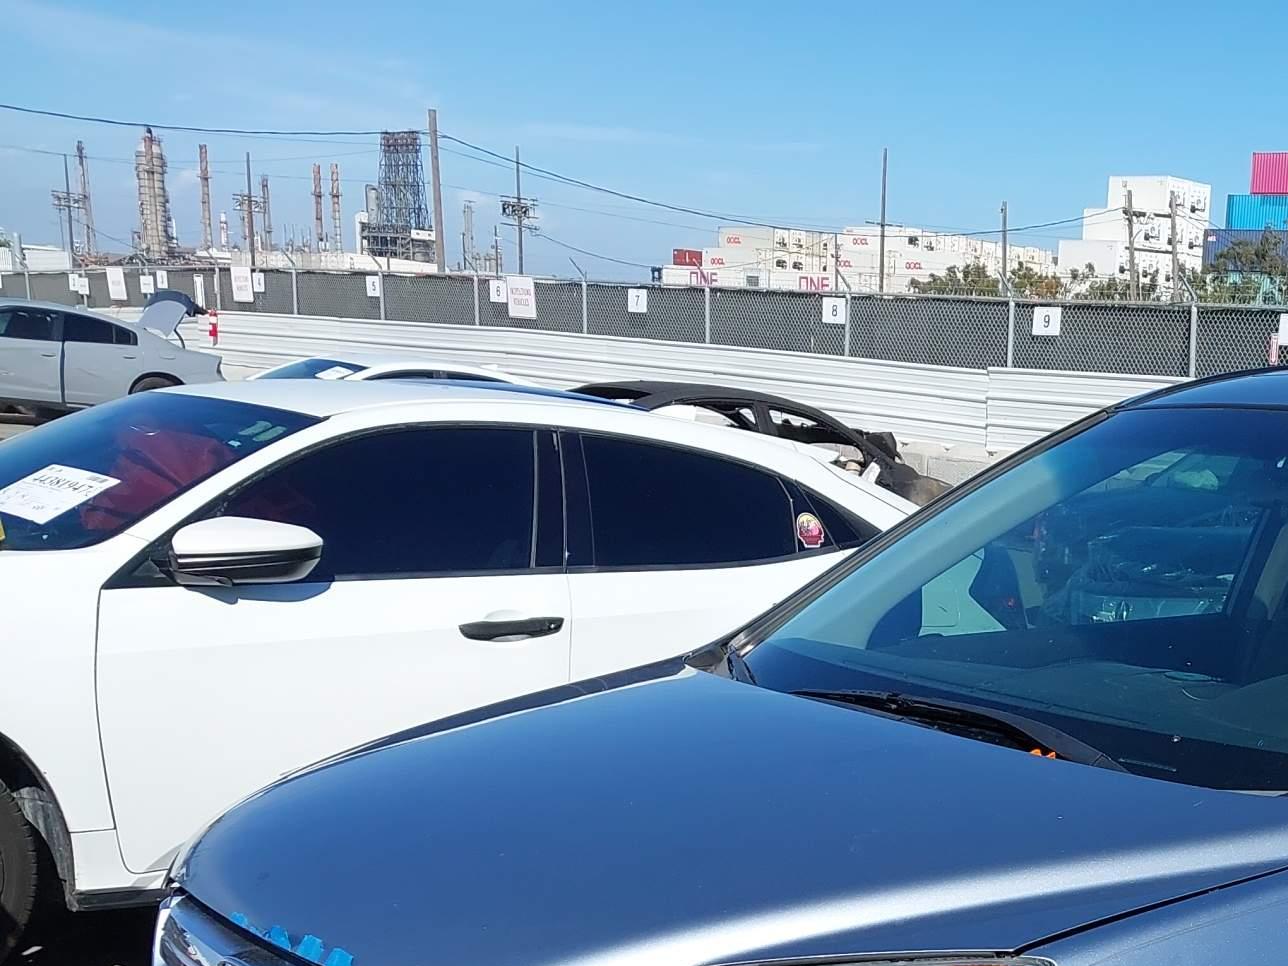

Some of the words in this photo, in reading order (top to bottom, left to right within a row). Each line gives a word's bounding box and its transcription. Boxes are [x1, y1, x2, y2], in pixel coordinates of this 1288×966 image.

[726, 235, 742, 244] OOCL
[852, 237, 869, 246] OOCL
[710, 257, 725, 266] OOCL
[905, 261, 923, 270] OOCL
[1043, 314, 1050, 328] 9
